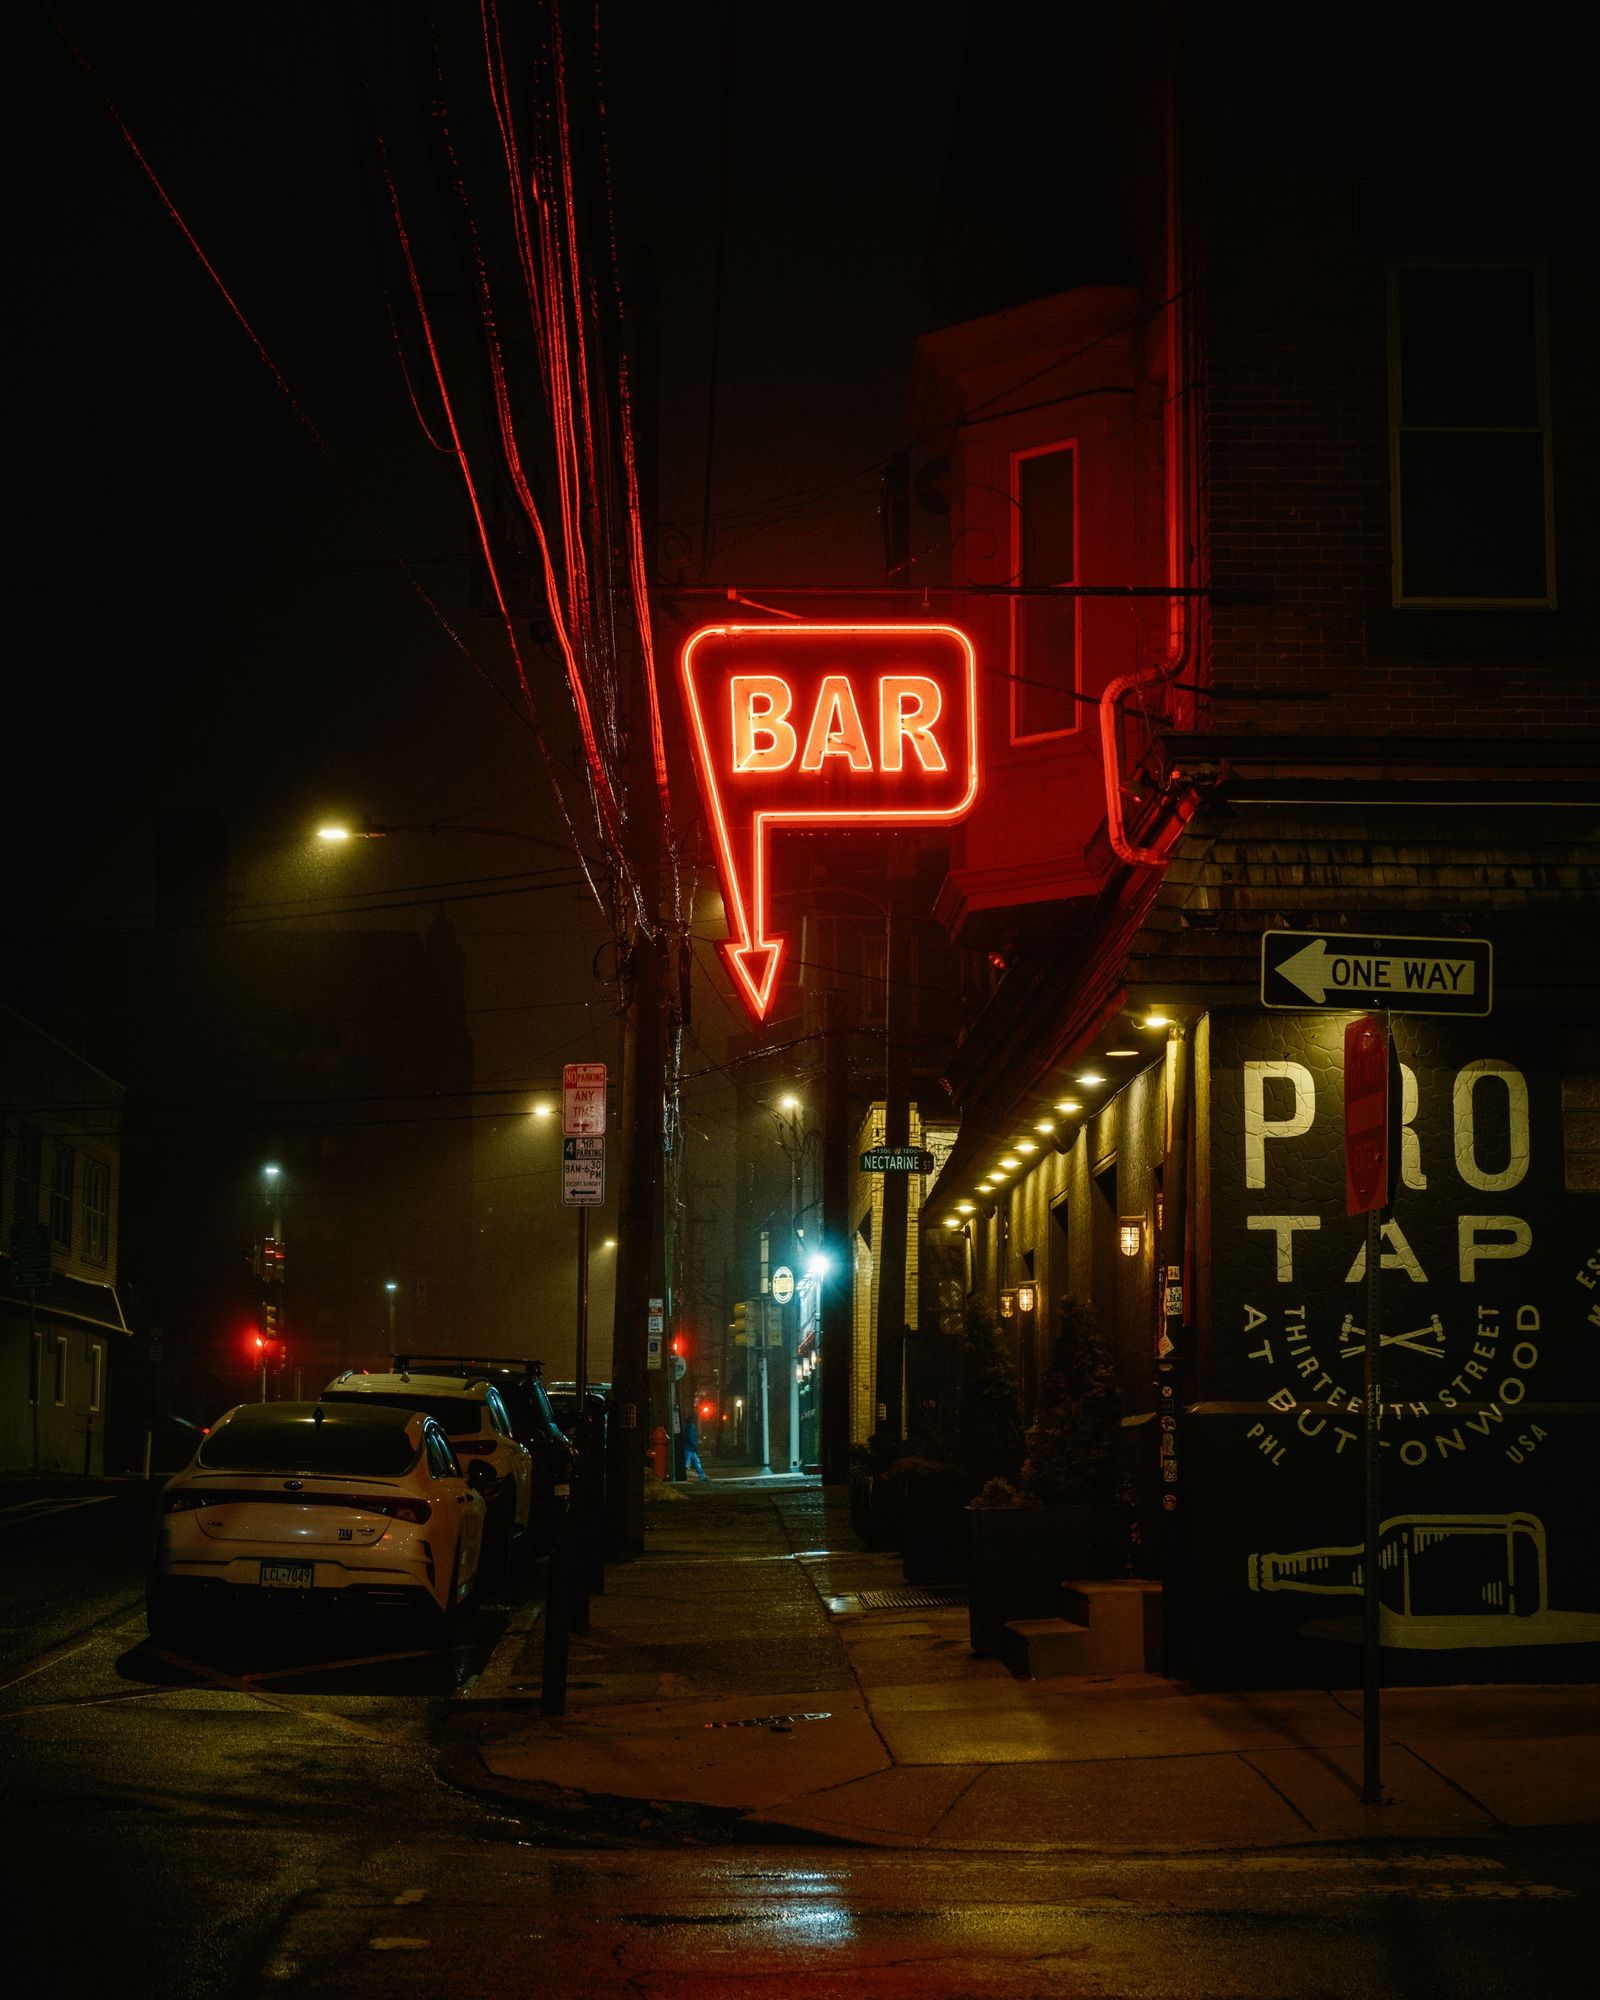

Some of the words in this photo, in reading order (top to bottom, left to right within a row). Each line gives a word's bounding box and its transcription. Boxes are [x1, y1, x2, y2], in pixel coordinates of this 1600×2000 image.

[730, 675, 948, 773] BAR
[1332, 958, 1391, 988] ONE
[1403, 962, 1466, 991] WAY
[566, 1070, 577, 1085] NO
[574, 1090, 594, 1102] ANY
[573, 1106, 595, 1118] TIME
[566, 1142, 575, 1155] 4
[864, 1155, 919, 1170] NECTARINE
[1247, 1215, 1533, 1283] TAP
[1244, 1304, 1274, 1364] AT
[1438, 1305, 1499, 1408] STREET
[1247, 1422, 1287, 1466] PHL
[1505, 1423, 1548, 1464] USA
